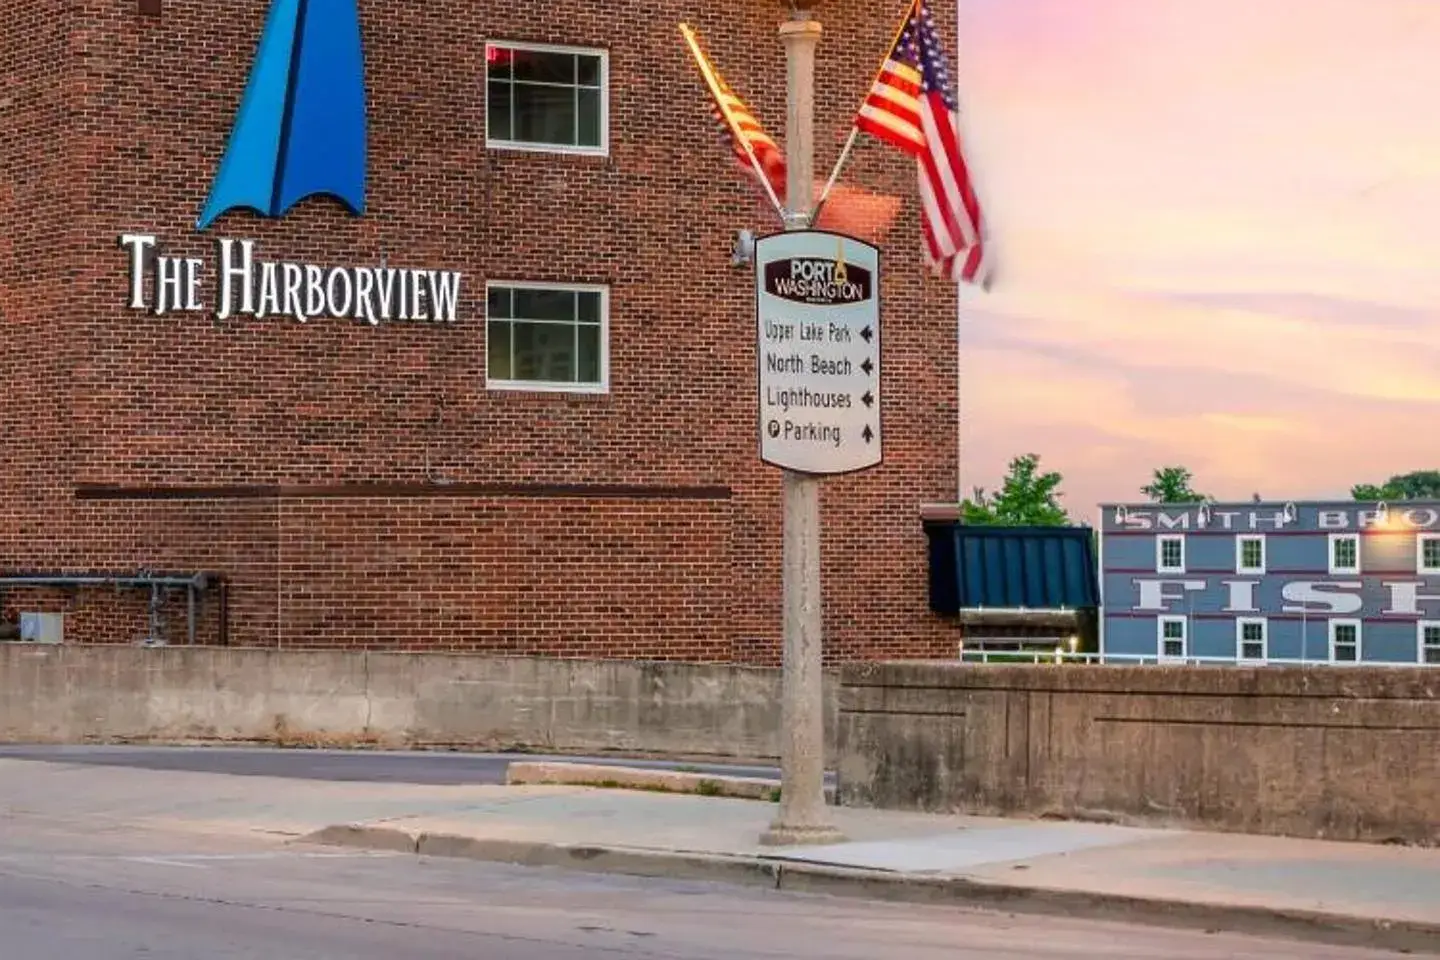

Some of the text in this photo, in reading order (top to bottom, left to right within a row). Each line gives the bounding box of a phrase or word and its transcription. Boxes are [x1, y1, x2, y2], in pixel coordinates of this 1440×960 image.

[122, 234, 461, 326] THE HARBORVIEW
[791, 259, 835, 281] PORT
[774, 277, 863, 300] WASHINGTON
[765, 320, 852, 342] Upper Lake Park
[766, 351, 852, 376] North Beach
[766, 385, 852, 412] Lighthouses
[784, 420, 841, 448] Parking
[1123, 511, 1285, 530] SMITH
